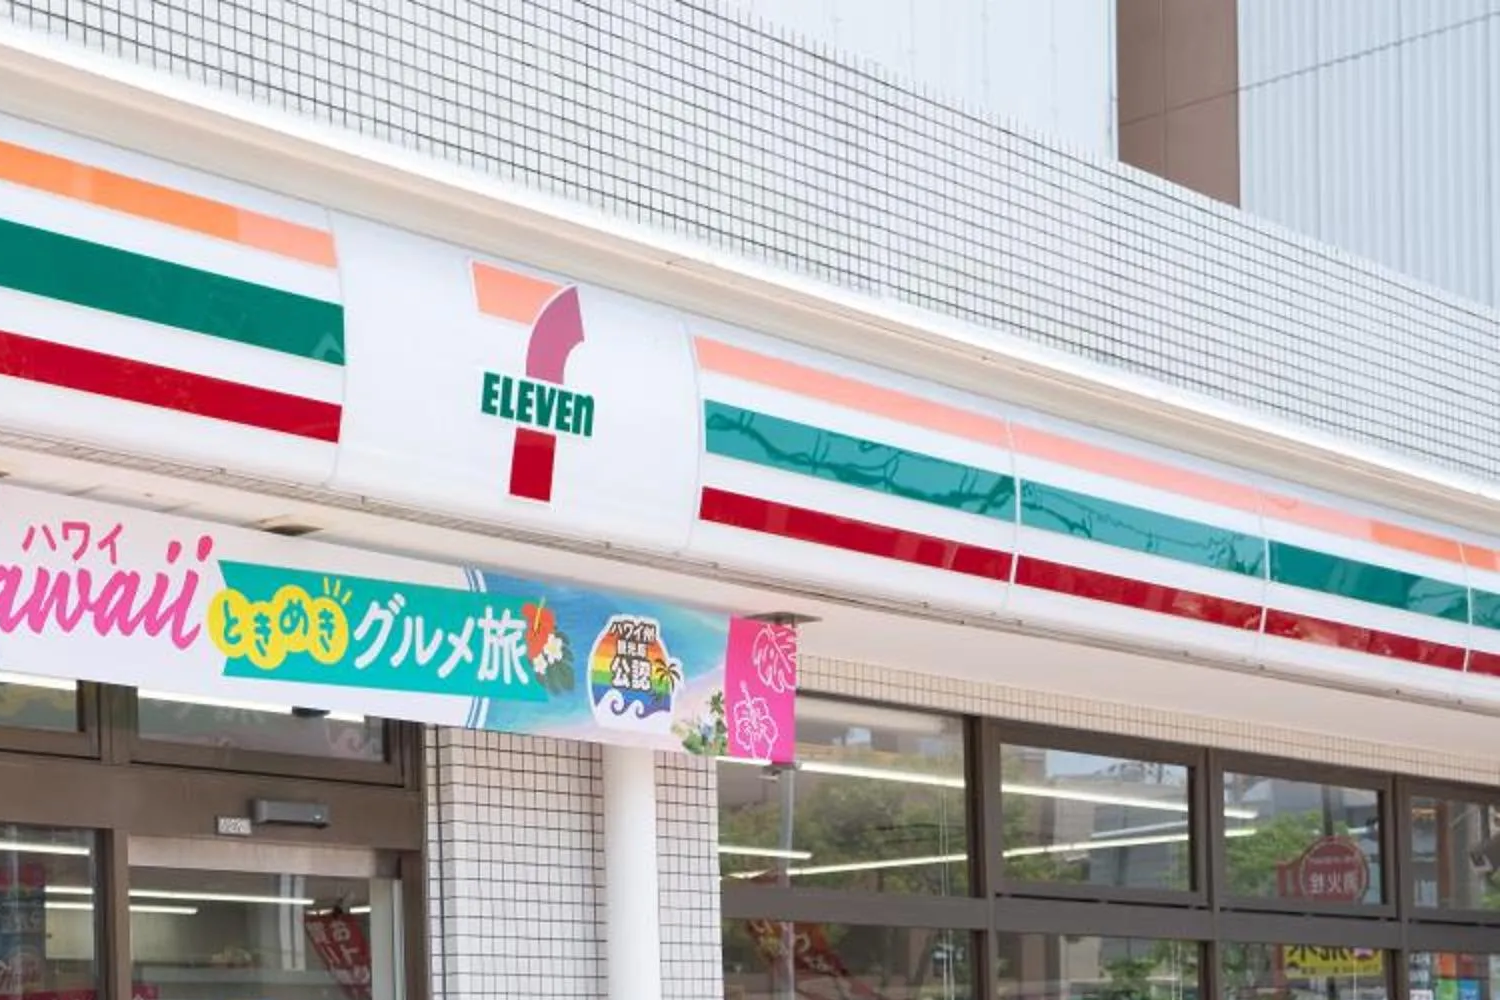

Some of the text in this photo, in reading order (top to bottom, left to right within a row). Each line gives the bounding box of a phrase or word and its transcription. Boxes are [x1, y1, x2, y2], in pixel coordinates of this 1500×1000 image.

[22, 522, 123, 565] ハワイ
[221, 592, 529, 685] ときめき グルメ旅
[611, 656, 652, 691] 公認
